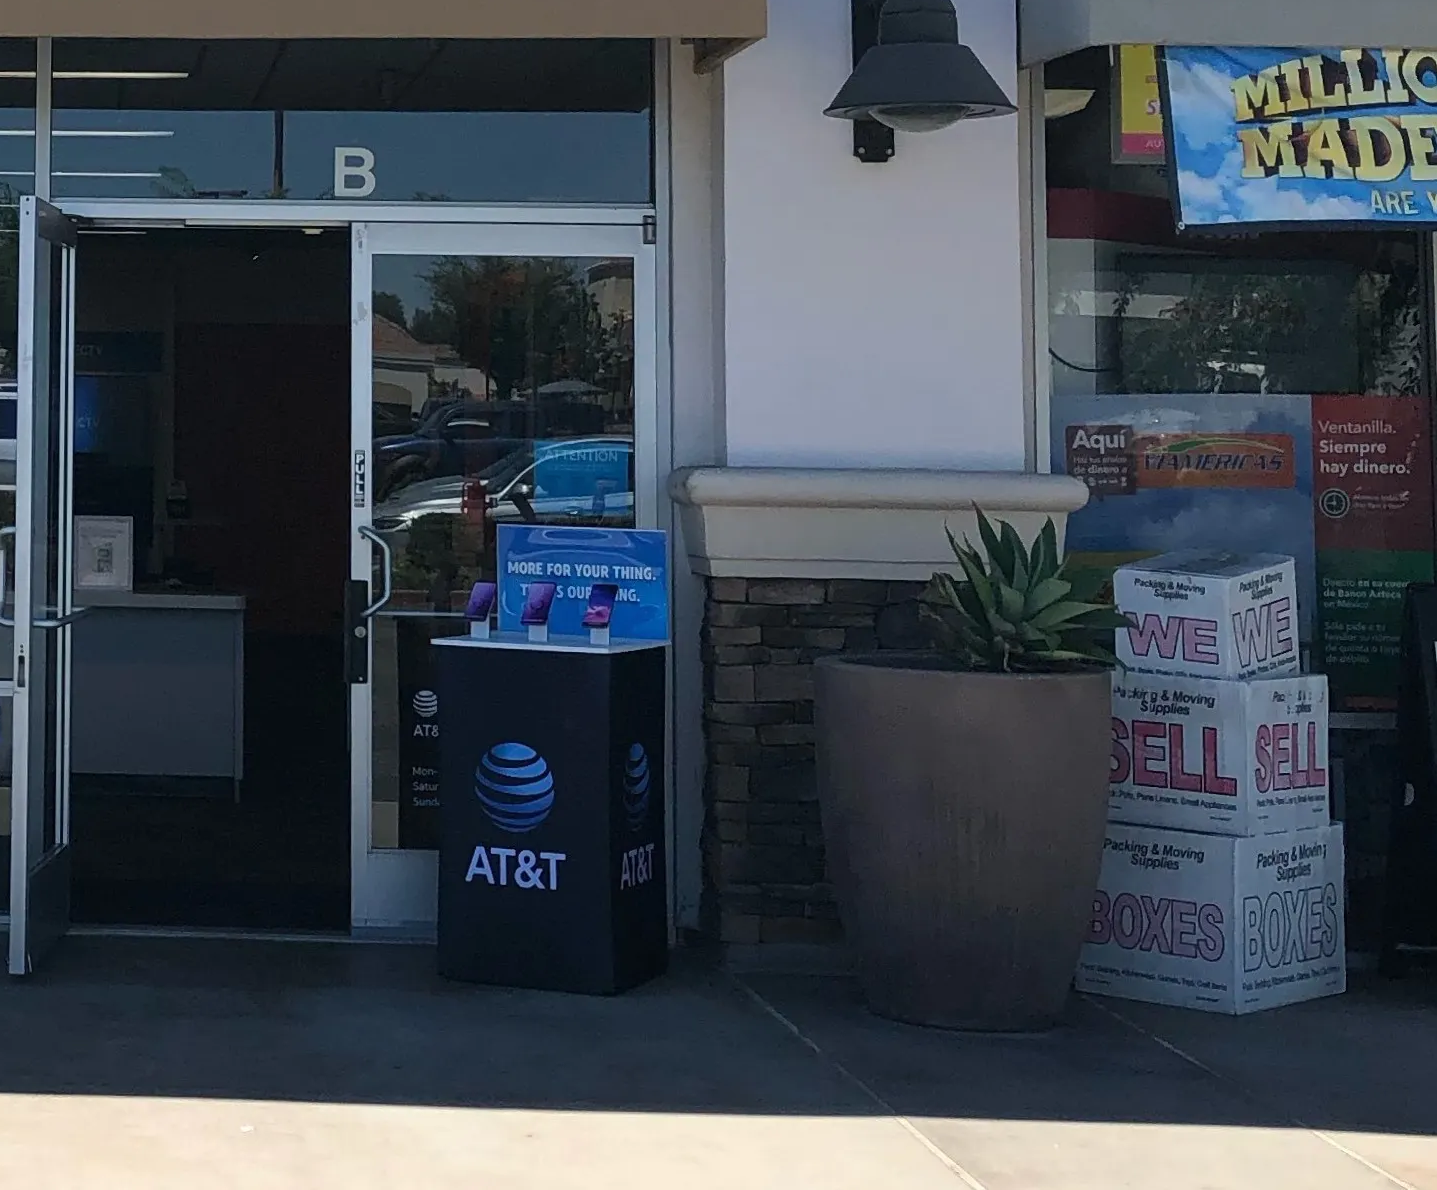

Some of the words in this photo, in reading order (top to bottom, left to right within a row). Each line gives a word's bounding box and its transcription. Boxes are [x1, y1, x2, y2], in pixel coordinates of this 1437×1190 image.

[334, 146, 376, 197] B
[1370, 189, 1419, 215] ARE
[1318, 419, 1397, 434] Ventanilla.
[1072, 429, 1127, 455] Aquí
[1319, 440, 1387, 457] Siempre
[545, 448, 619, 462] ATTENTION
[355, 453, 365, 495] PULL
[1319, 459, 1349, 477] hay
[1353, 459, 1411, 475] dinero.
[507, 560, 544, 576] MORE
[546, 562, 572, 578] FOR
[574, 564, 610, 580] YOUR
[612, 566, 657, 582] THING.
[519, 582, 565, 599] TS
[1133, 577, 1166, 591] Packing
[1167, 581, 1175, 591] &
[1176, 583, 1206, 595] Moving
[1259, 575, 1265, 588] &
[1153, 589, 1188, 601] Supplies
[1123, 610, 1219, 665] WE
[1232, 596, 1293, 669] WE
[1161, 689, 1171, 702] &
[1172, 691, 1216, 708] Moving
[1139, 701, 1190, 716] Supplies
[413, 724, 440, 738] AT&
[1110, 716, 1237, 797] SELL
[1255, 720, 1325, 794] SELL
[412, 766, 438, 777] Mon-
[412, 781, 440, 792] Satur
[412, 796, 440, 808] Sund
[1103, 838, 1148, 858] Packing
[1152, 843, 1161, 857] &
[1162, 846, 1205, 864] Moving
[1256, 849, 1290, 870] Packing
[1291, 846, 1298, 862] &
[464, 844, 567, 891] AT&T
[620, 842, 655, 891] AT&T
[1130, 854, 1180, 870] Supplies
[1276, 863, 1311, 882] Supplies
[1084, 890, 1225, 962] BOXES
[1242, 883, 1338, 973] BOXES
